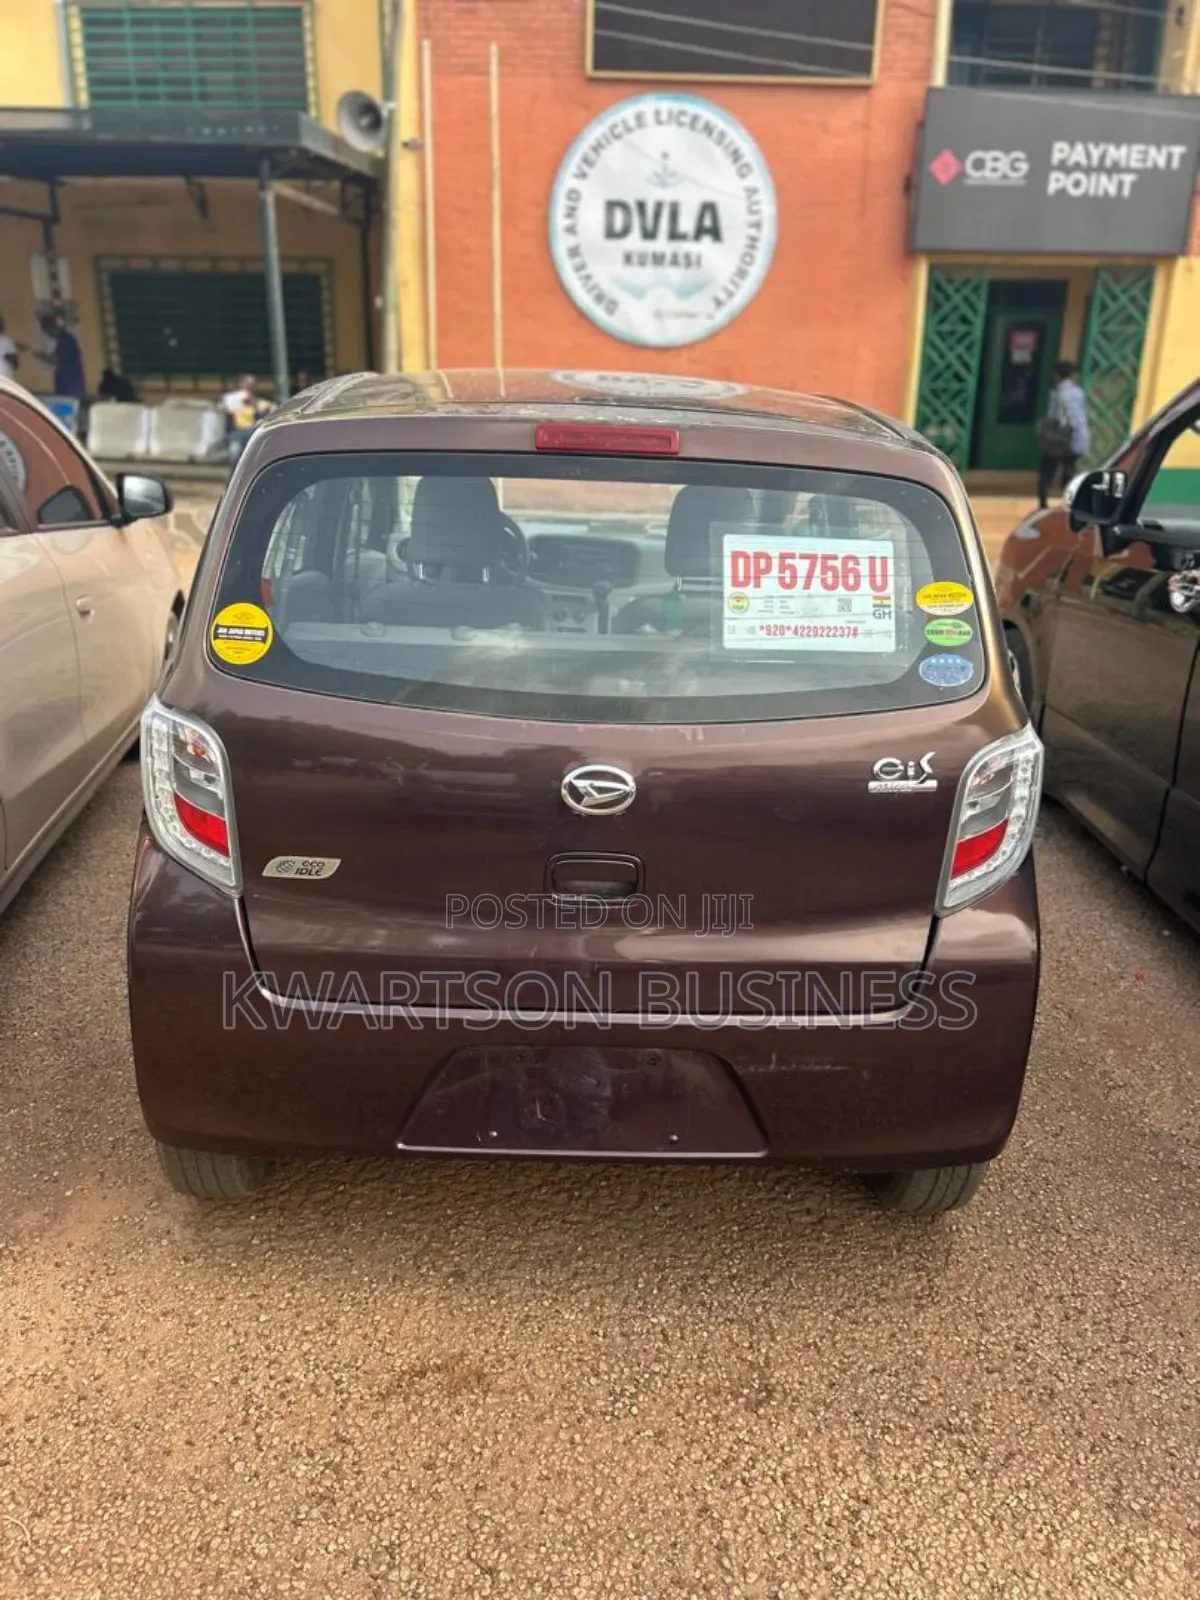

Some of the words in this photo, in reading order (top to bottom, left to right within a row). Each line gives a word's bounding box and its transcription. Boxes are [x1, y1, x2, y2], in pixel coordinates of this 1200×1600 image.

[573, 109, 648, 181] VEHICLE
[654, 108, 755, 180] LICENSING
[964, 150, 1030, 178] CBG
[1051, 141, 1187, 171] PAYMENT
[1047, 171, 1138, 198] POINT
[562, 187, 582, 237] AND
[603, 199, 723, 243] DVLA
[622, 252, 702, 269] KUMASI
[712, 185, 764, 312] AUTHORITY
[566, 244, 620, 317] DRIVER
[730, 550, 773, 589] DP
[778, 552, 861, 592] 5756
[868, 556, 889, 592] U
[872, 608, 893, 620] GH
[294, 868, 323, 876] IDLE
